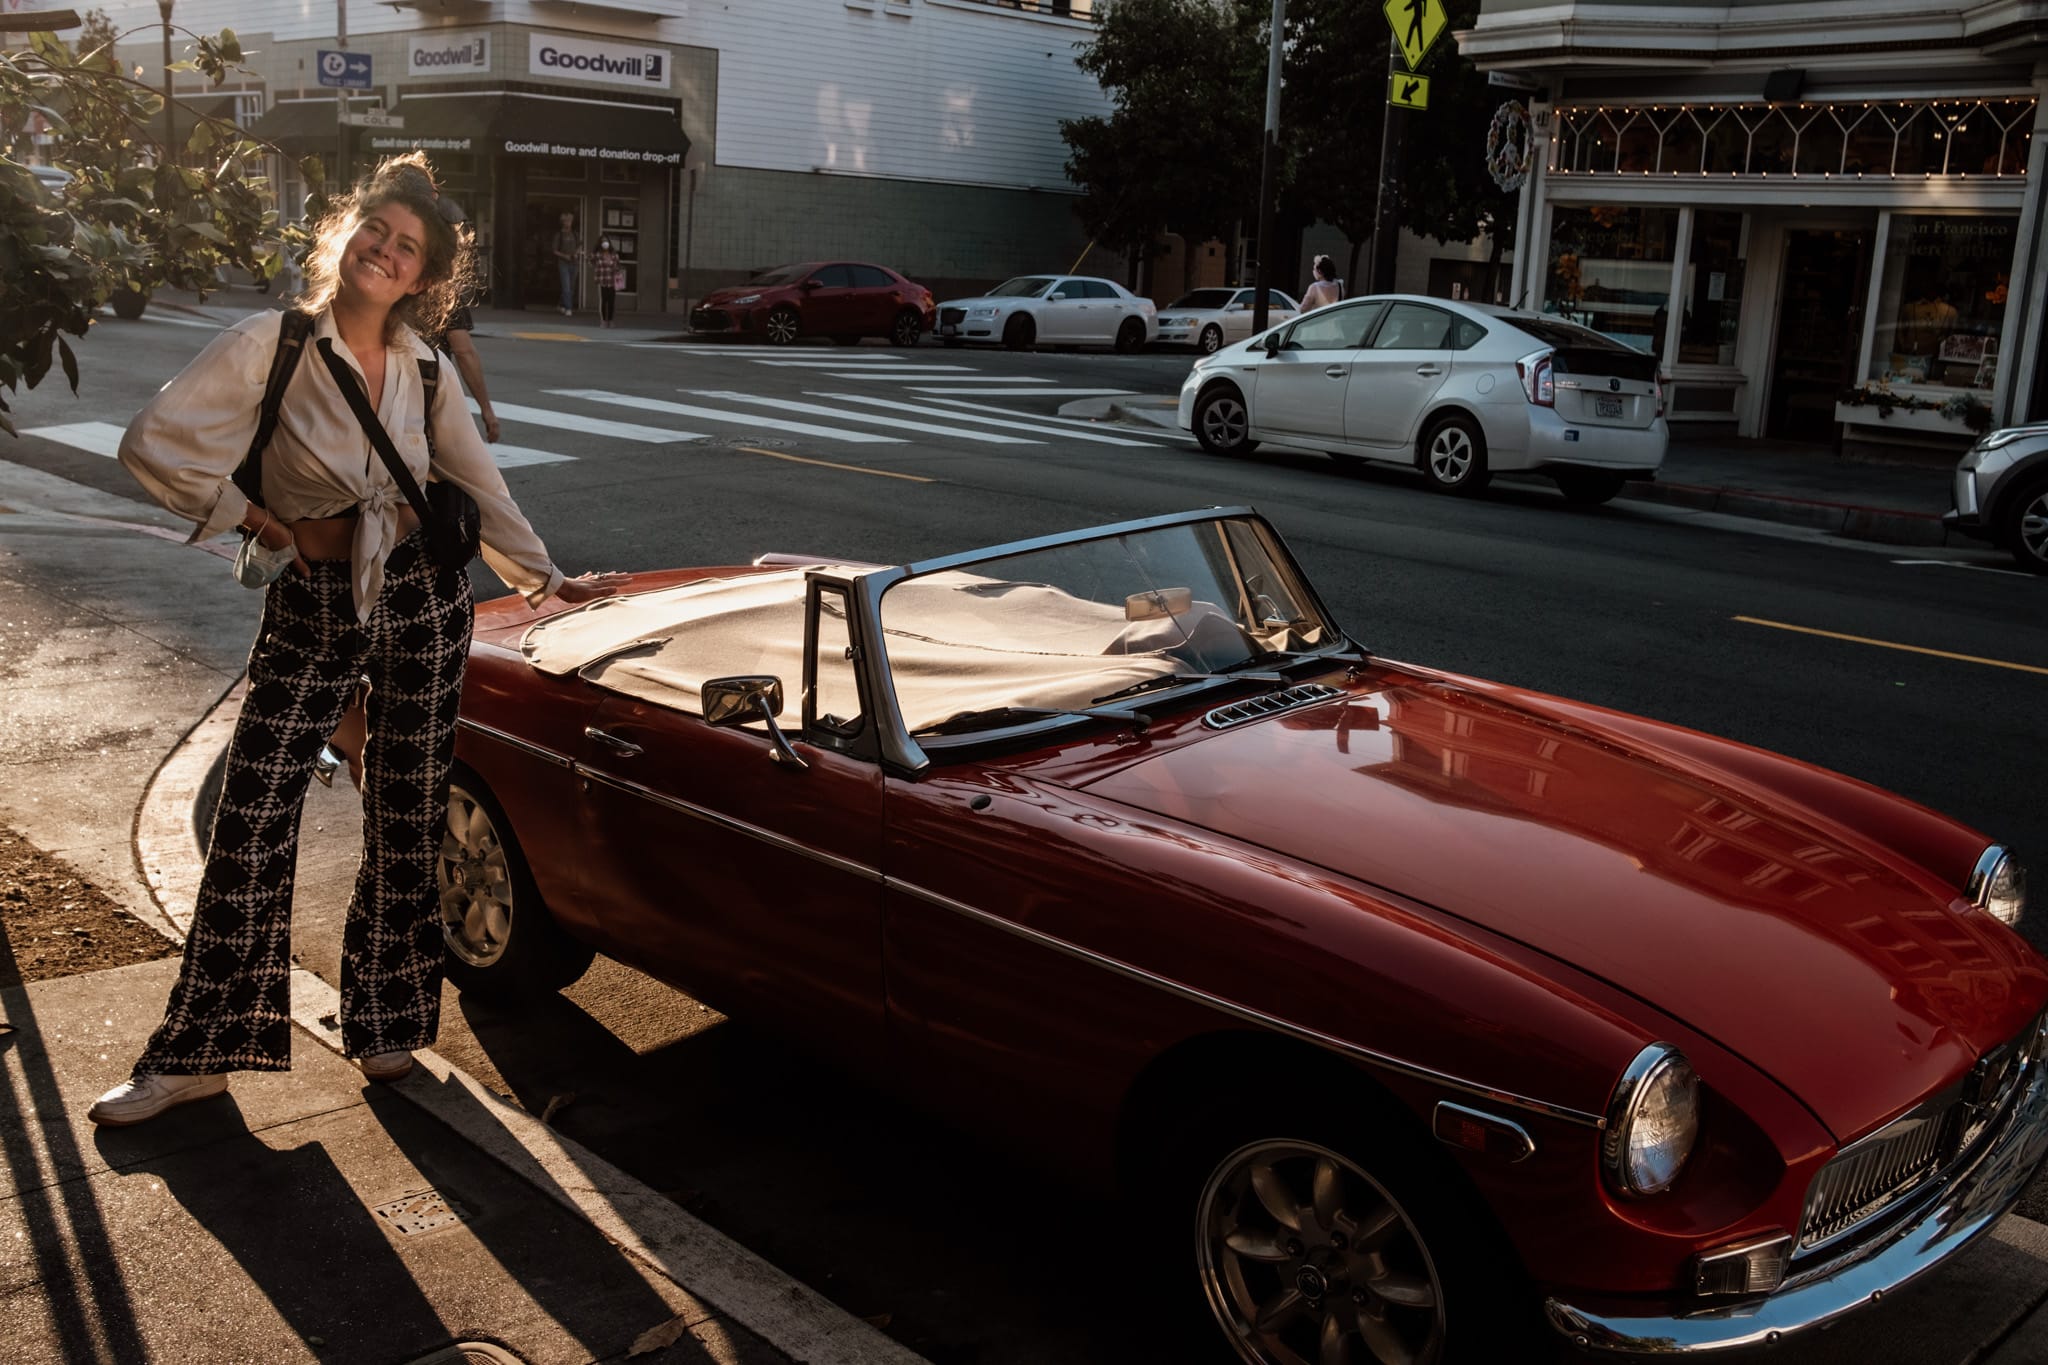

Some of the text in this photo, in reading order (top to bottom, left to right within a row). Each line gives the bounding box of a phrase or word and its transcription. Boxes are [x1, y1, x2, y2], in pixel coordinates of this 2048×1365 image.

[414, 44, 472, 67] Goodwill
[539, 47, 642, 76] Goodwill
[363, 116, 392, 126] COLE
[504, 140, 681, 164] Goodwill store and donation drop-off
[1933, 219, 2008, 236] Francisco
